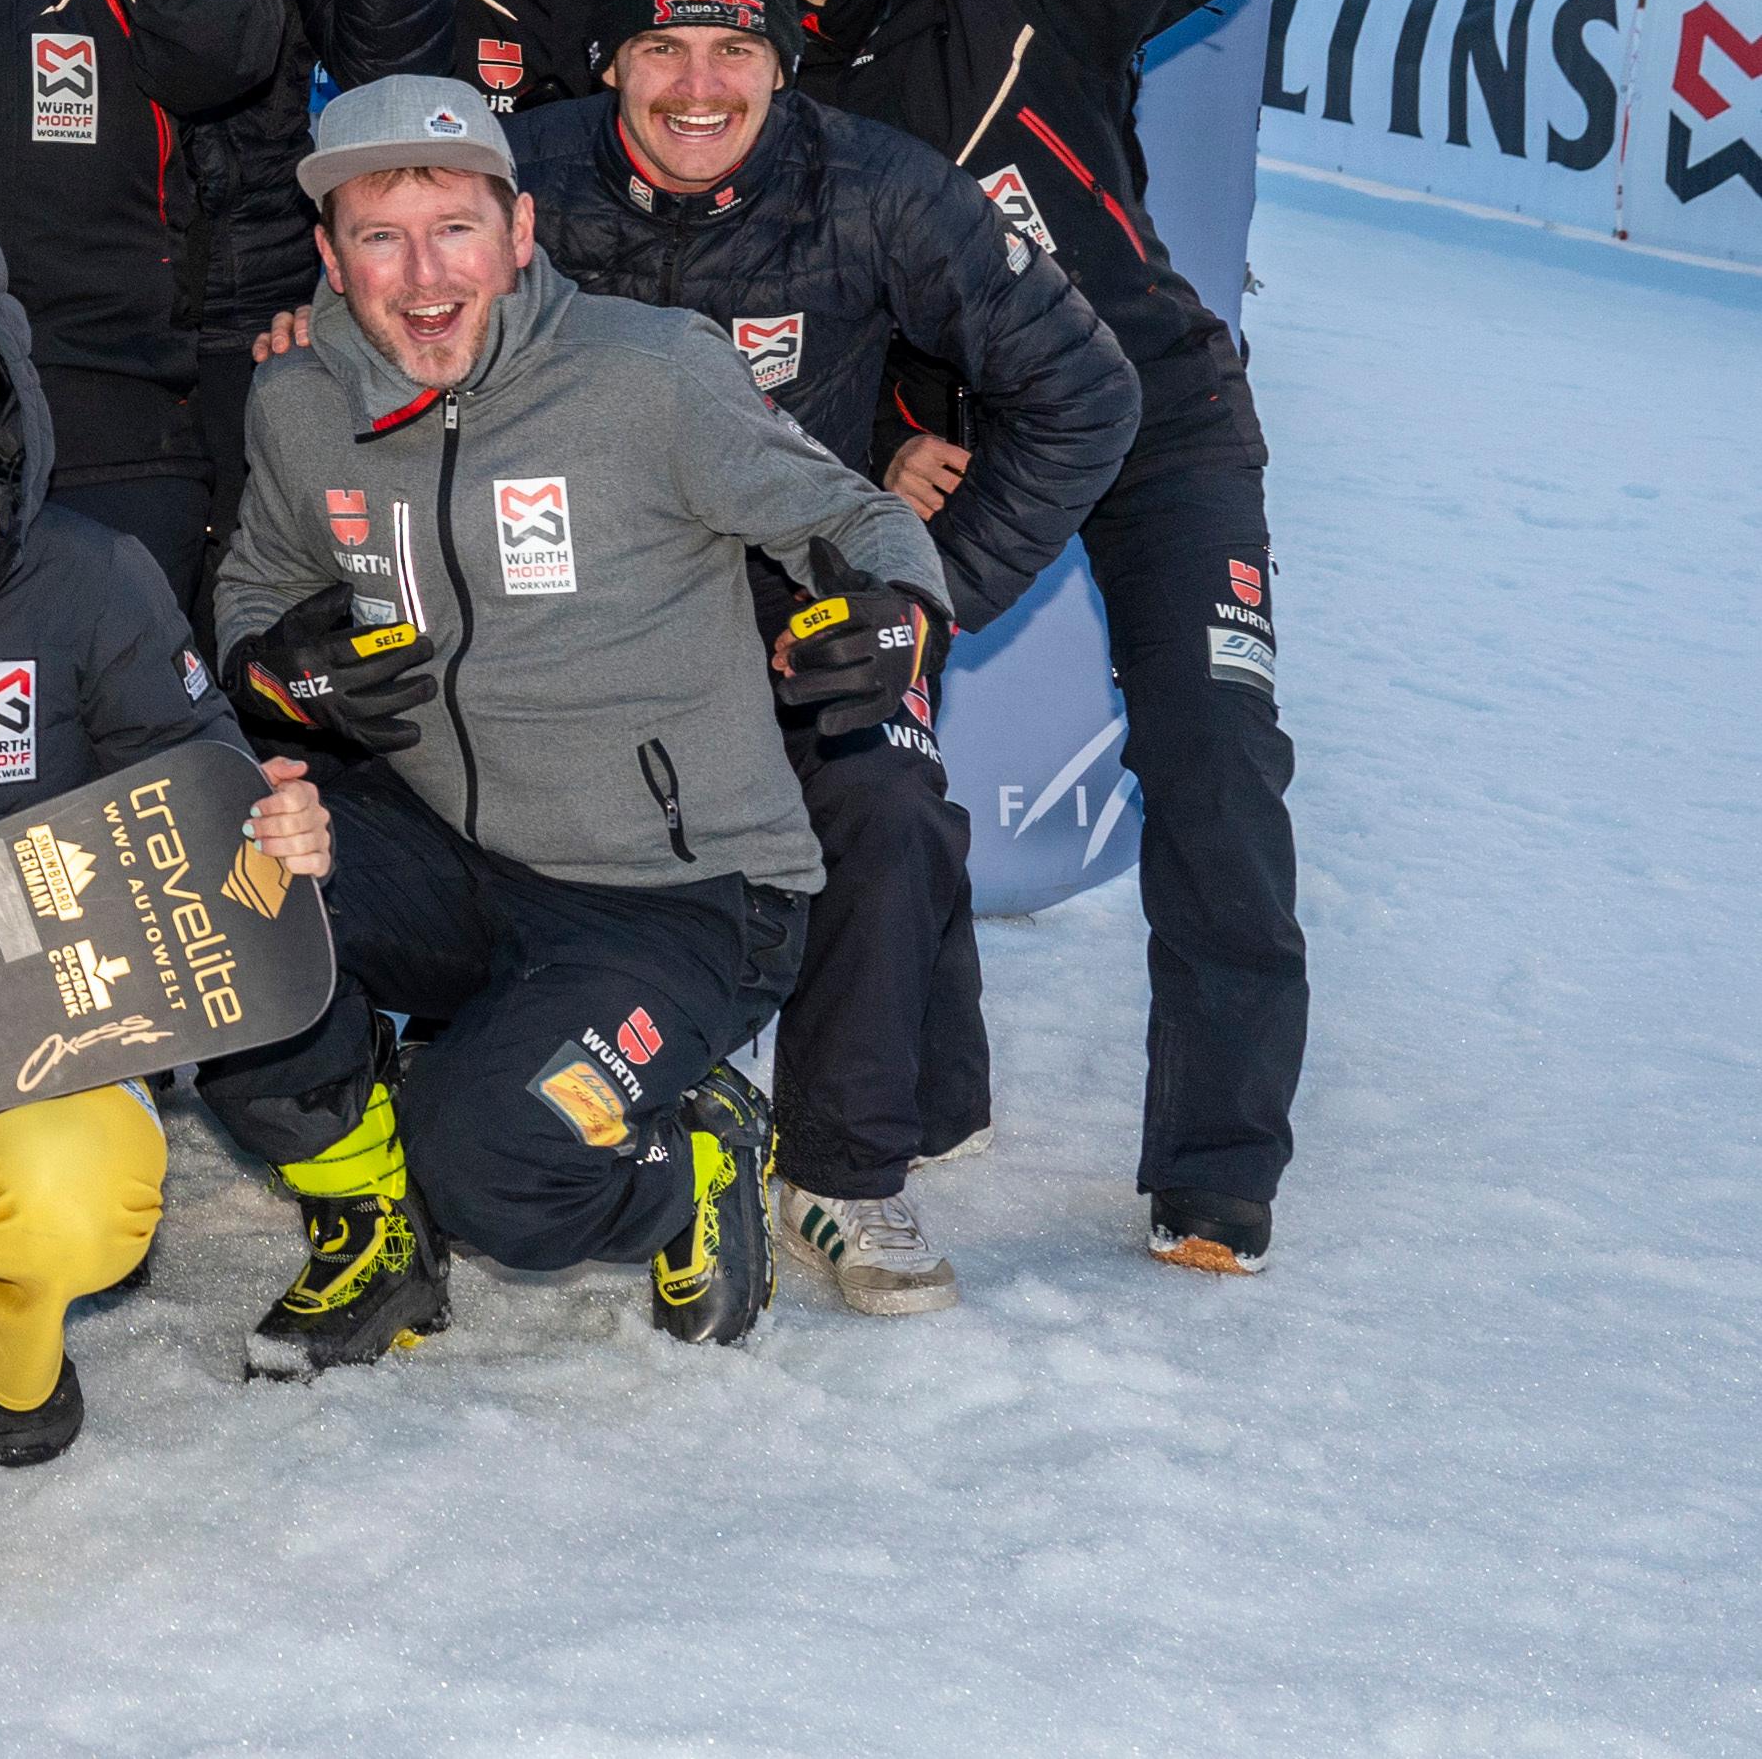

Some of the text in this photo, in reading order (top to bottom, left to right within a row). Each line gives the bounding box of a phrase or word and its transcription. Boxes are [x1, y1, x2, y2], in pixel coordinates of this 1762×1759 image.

[37, 115, 92, 127] MODYF
[37, 129, 92, 139] WORKWEAR
[507, 565, 569, 578] MODYF
[509, 579, 571, 590] WORKWEAR
[13, 838, 57, 918] GERMANY
[36, 833, 73, 912] SNOWBOARD
[103, 801, 187, 1010] WWG AUTOWELT
[129, 778, 243, 1028] travelite
[48, 949, 82, 1019] C-SINK
[61, 945, 91, 1015] GLOBAL
